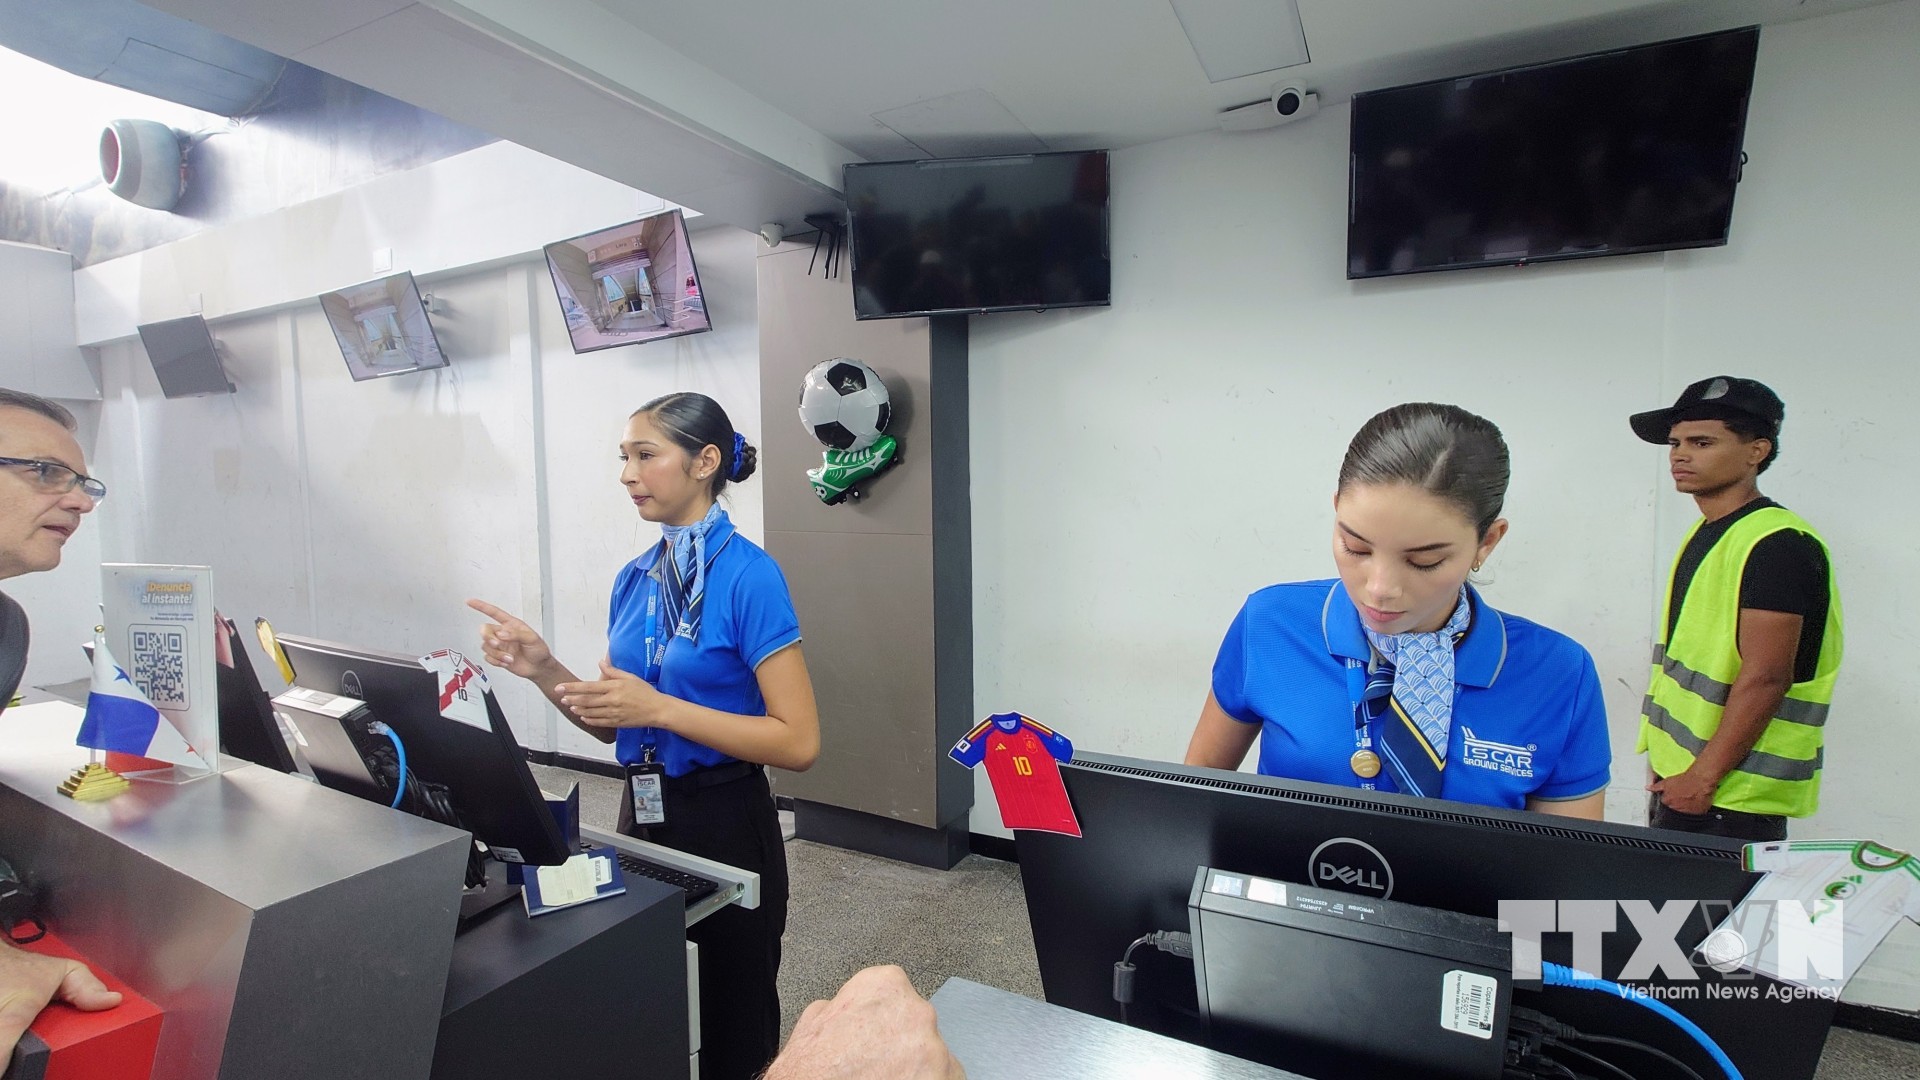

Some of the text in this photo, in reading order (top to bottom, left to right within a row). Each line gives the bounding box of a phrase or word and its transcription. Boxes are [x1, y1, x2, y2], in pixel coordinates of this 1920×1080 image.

[142, 593, 193, 604] al instante!
[344, 683, 361, 696] DELL
[458, 688, 468, 702] 10
[1463, 757, 1498, 771] GROUND
[1464, 744, 1532, 769] ISCAR
[1013, 756, 1033, 776] 10
[1319, 862, 1385, 891] DELL
[1460, 993, 1470, 1015] 156929
